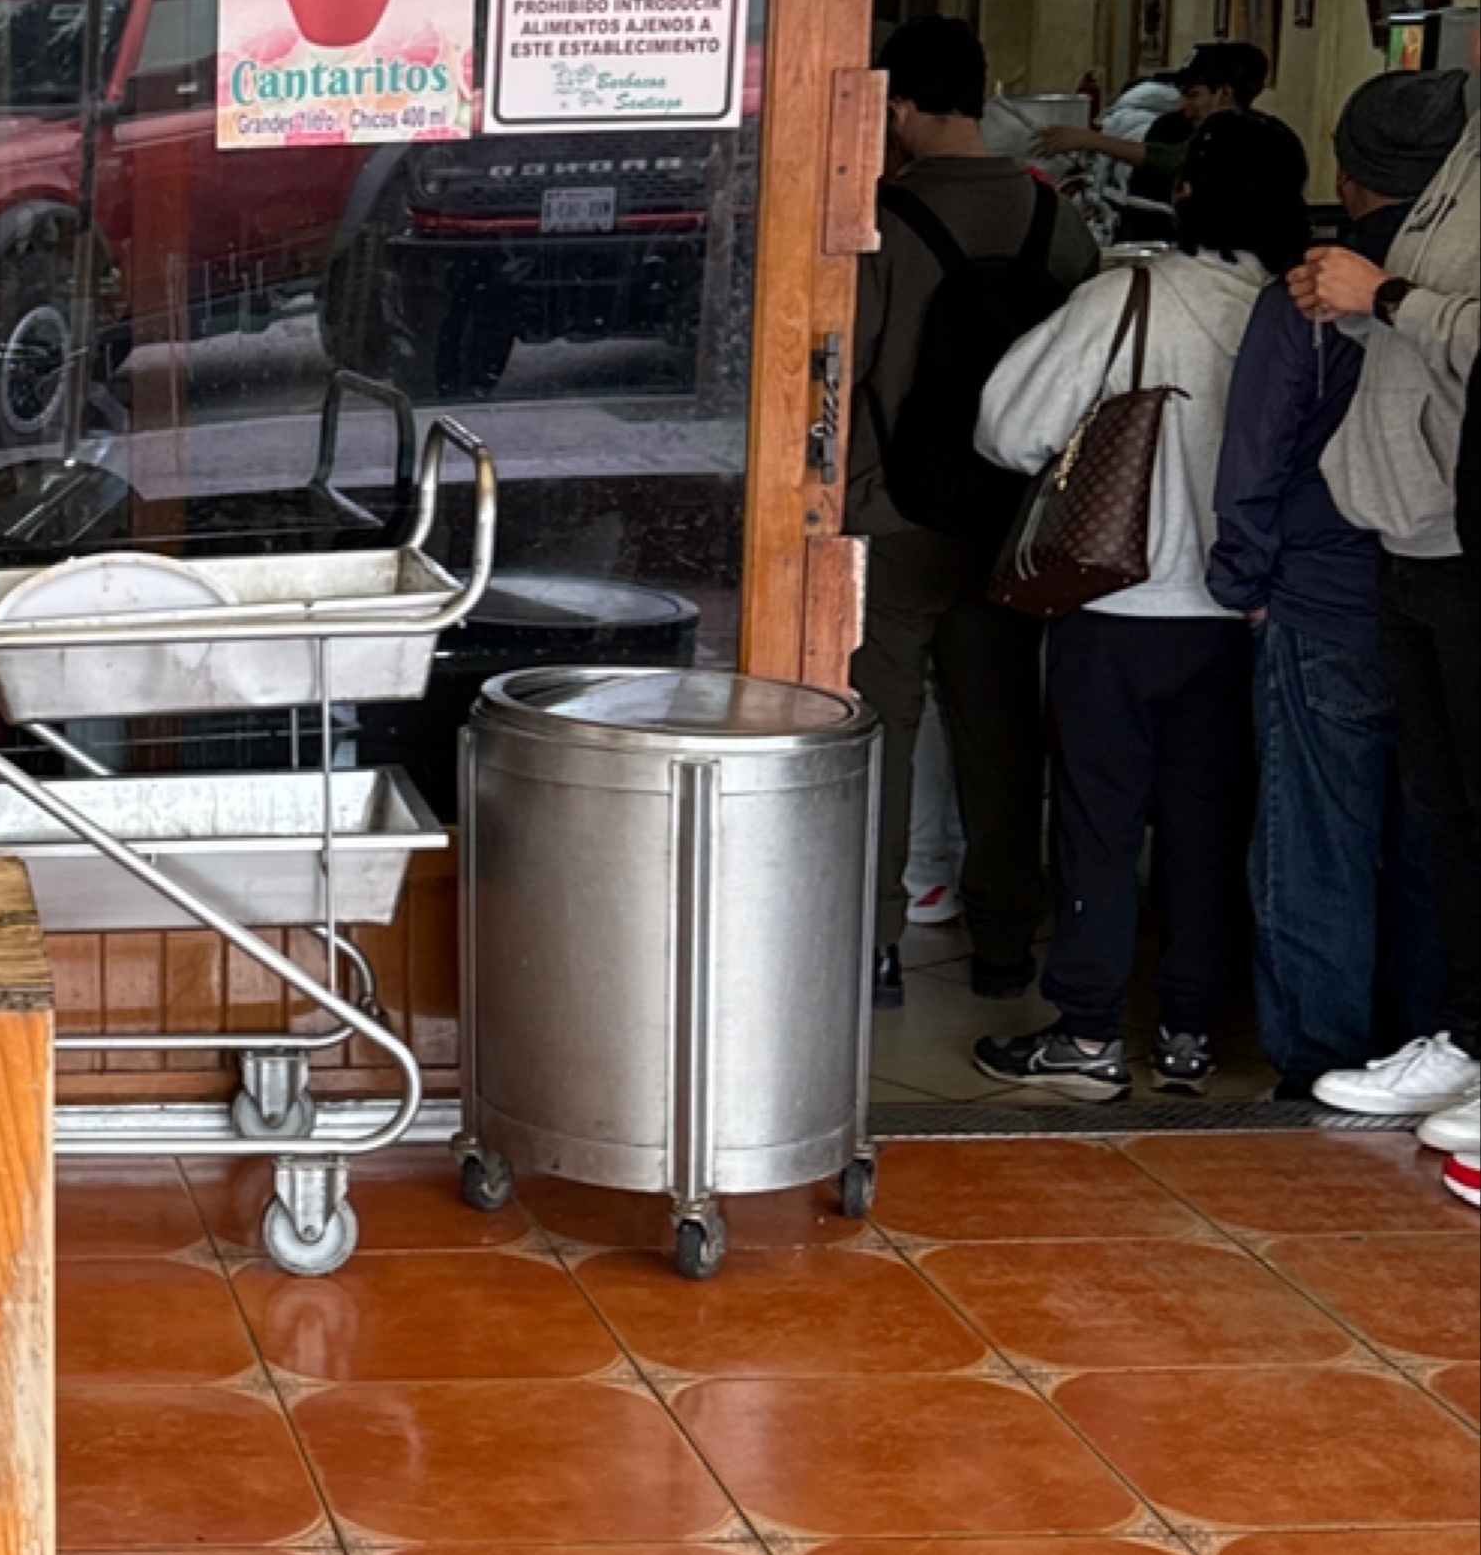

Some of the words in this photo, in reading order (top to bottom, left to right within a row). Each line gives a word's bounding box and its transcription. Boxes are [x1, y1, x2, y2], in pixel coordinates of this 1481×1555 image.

[520, 18, 621, 35] ALIMENTOS
[625, 16, 695, 33] AJENOS
[699, 17, 711, 32] A
[510, 42, 553, 59] ESTE
[558, 36, 720, 56] ESTABLECIMIENTO
[232, 58, 449, 104] Cantaritos
